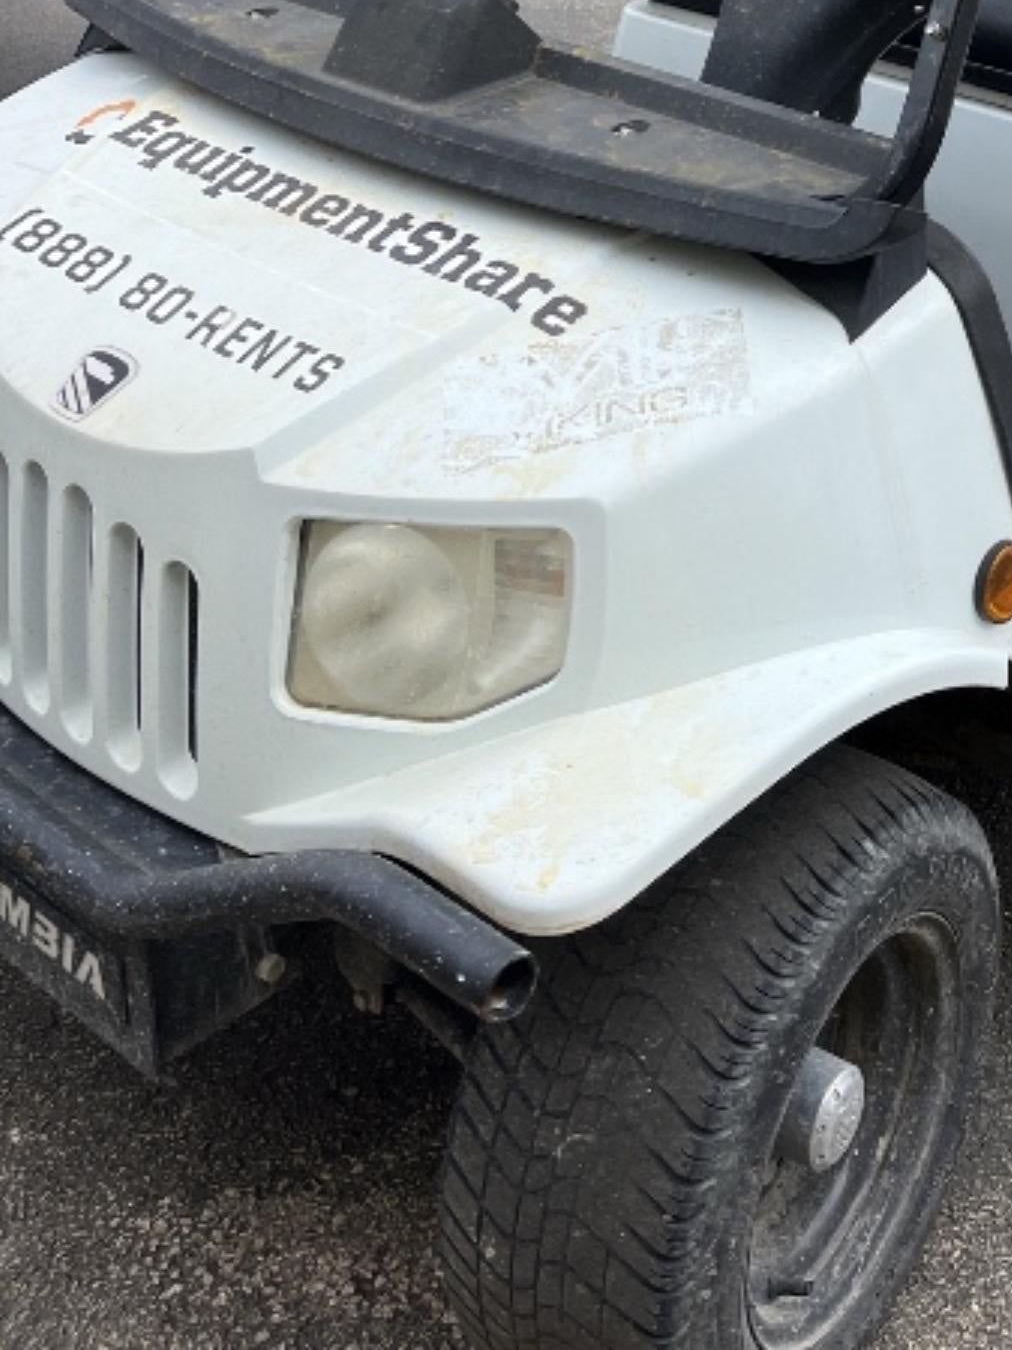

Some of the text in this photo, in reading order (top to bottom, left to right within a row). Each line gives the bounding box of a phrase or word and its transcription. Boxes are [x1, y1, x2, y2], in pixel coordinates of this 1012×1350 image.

[0, 208, 346, 393] (888) 80-RENTS
[107, 109, 588, 337] EquipmentShare
